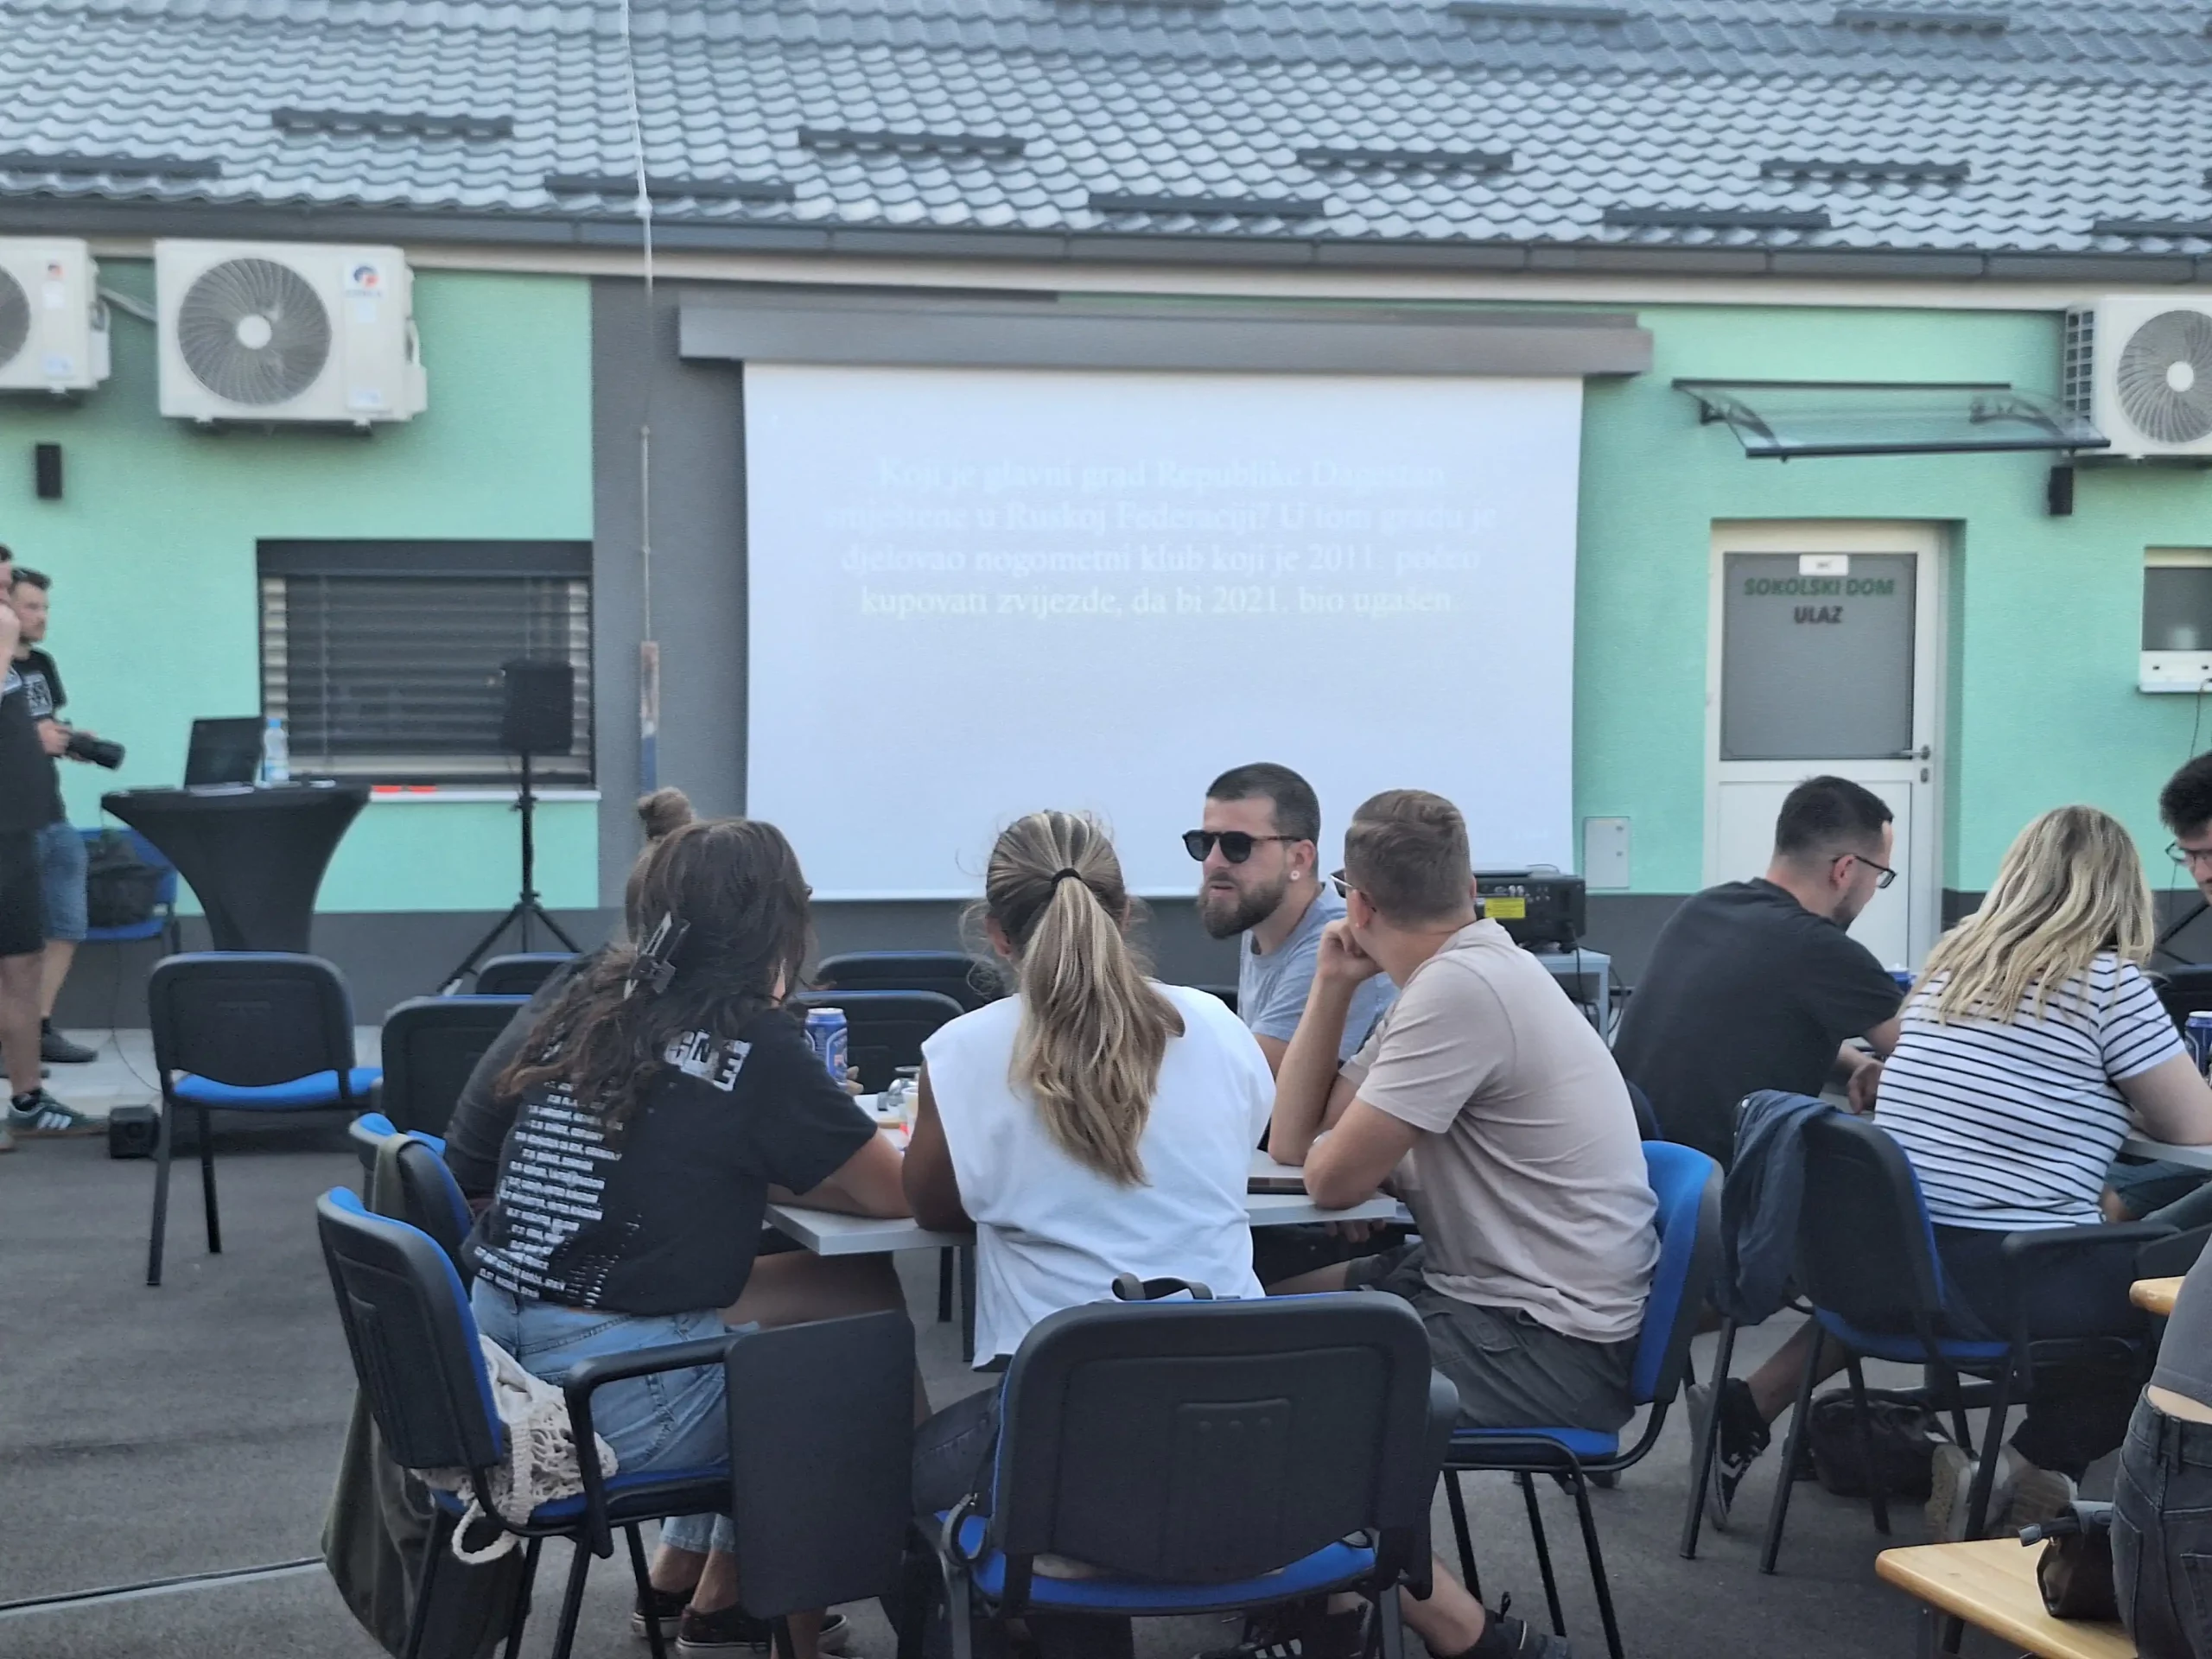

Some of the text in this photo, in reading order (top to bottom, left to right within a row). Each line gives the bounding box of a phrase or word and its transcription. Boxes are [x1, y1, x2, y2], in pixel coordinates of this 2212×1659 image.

[878, 457, 940, 492] Koji
[945, 459, 976, 495] je
[984, 458, 1071, 493] glavni
[1081, 459, 1146, 493] grad
[1158, 457, 1303, 494] Republike
[976, 505, 997, 528] u
[1007, 500, 1106, 537] Ruskoj
[1116, 500, 1270, 536] Federaciji?
[1280, 502, 1307, 529] U
[1314, 505, 1372, 528] tom
[1379, 501, 1464, 537] gradu
[1469, 499, 1498, 535] je
[840, 542, 967, 578] djelovao
[974, 542, 1131, 578] nogometni
[1141, 543, 1205, 571] klub
[1211, 542, 1268, 578] koji
[1270, 543, 1300, 578] je
[860, 585, 988, 620] kupovati
[995, 585, 1124, 620] zvijezde,
[1131, 586, 1167, 613] da
[1176, 586, 1203, 613] bi
[1211, 586, 1288, 613] 2021.
[1297, 586, 1344, 613] bio
[1744, 577, 1895, 596] SOKOLSKI DOM
[1793, 606, 1843, 624] ULAZ
